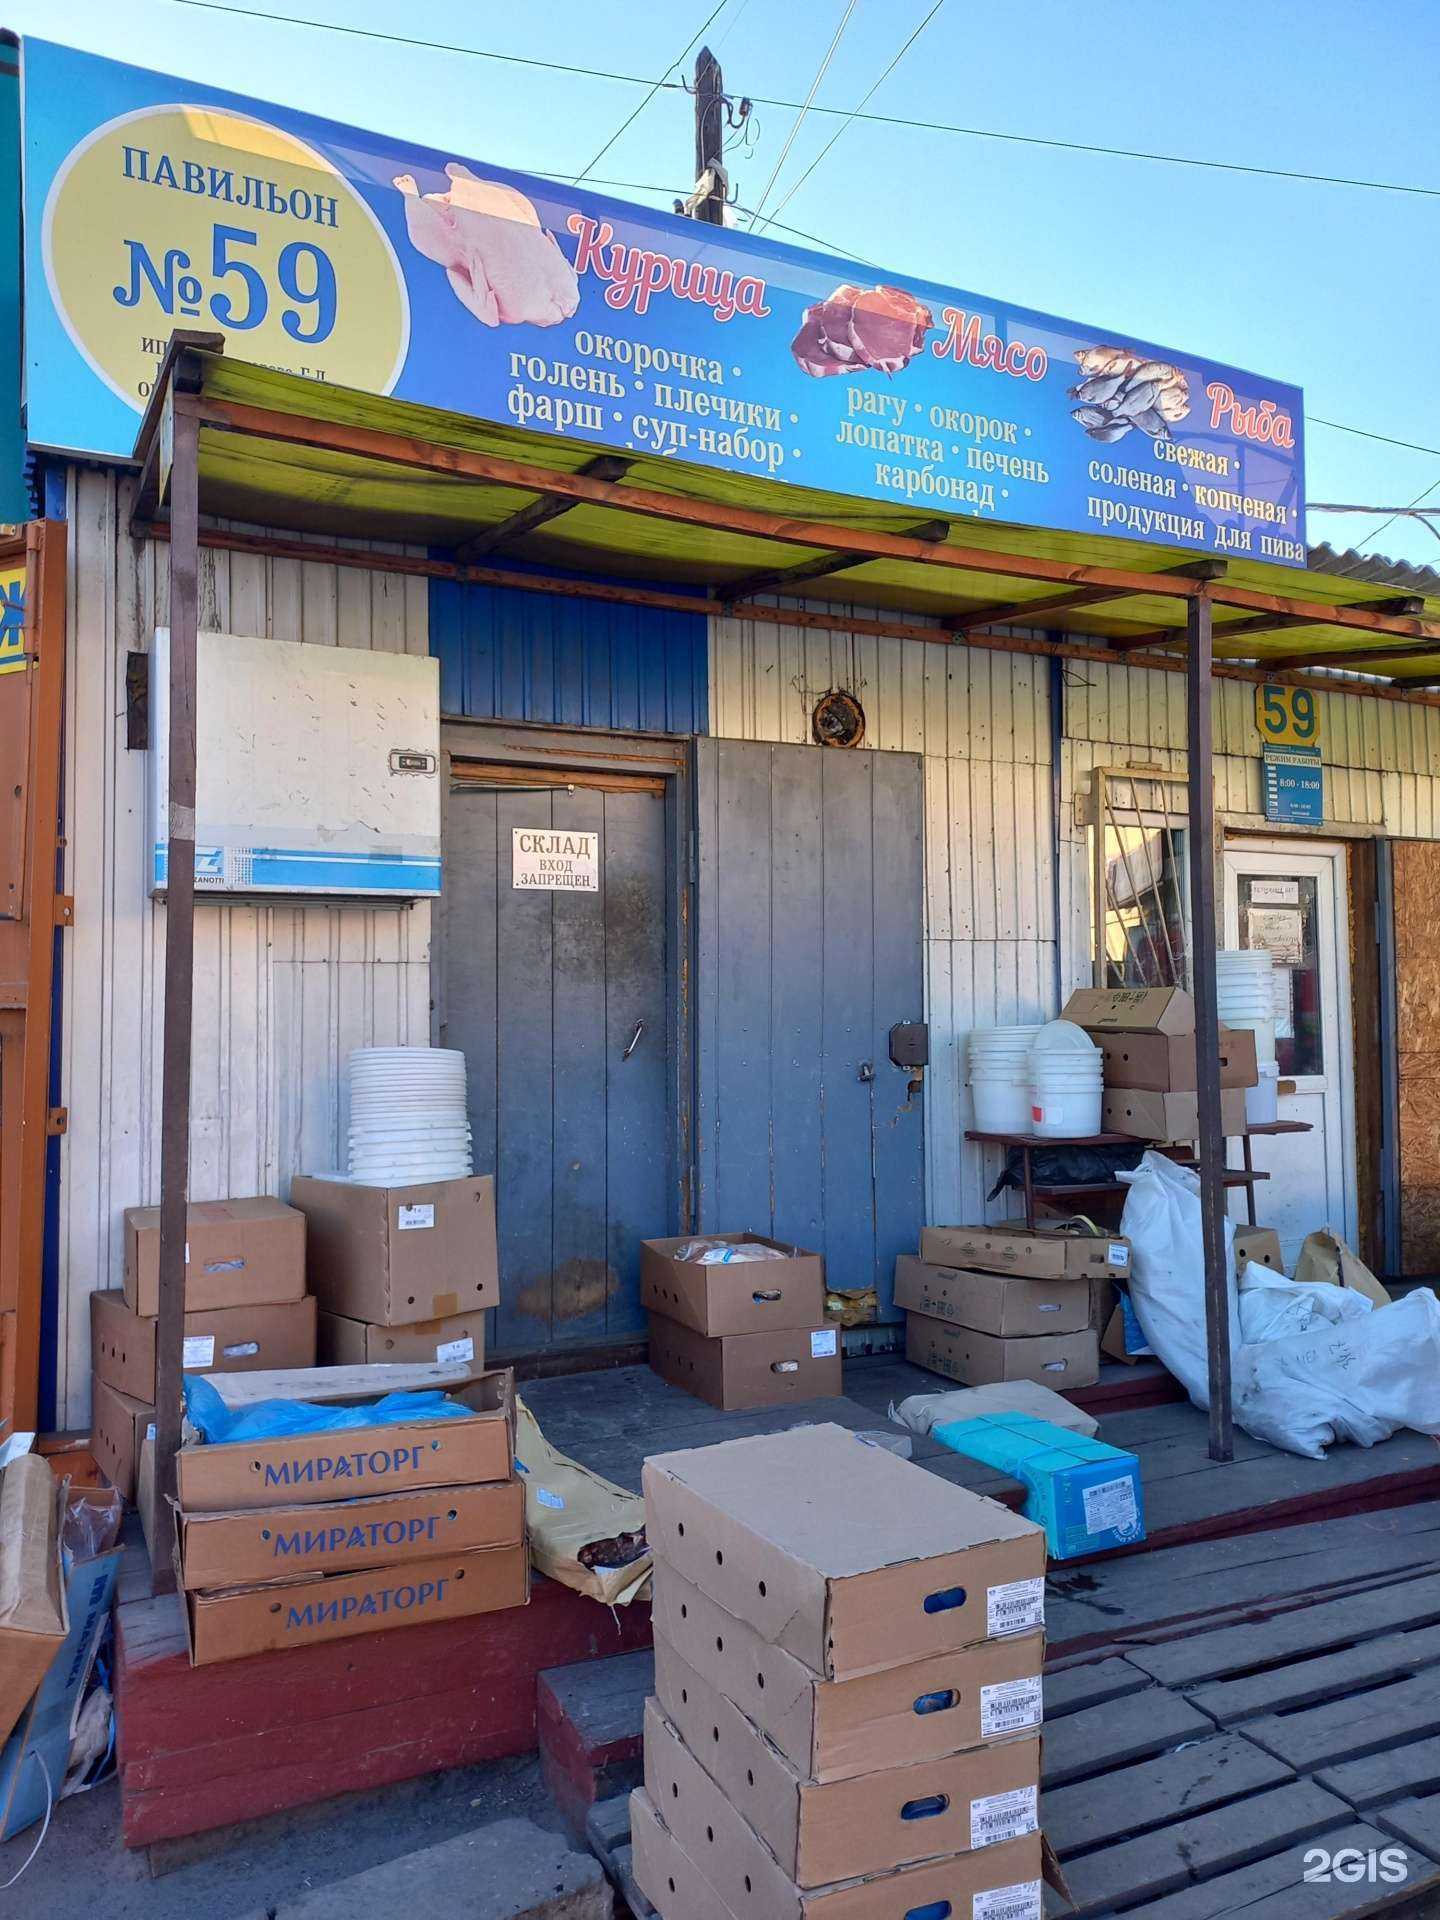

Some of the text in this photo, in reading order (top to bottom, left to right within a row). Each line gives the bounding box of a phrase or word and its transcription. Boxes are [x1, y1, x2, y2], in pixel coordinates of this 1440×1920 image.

[122, 145, 339, 228] ПАВИЛЬОН
[567, 213, 771, 321] Курица
[575, 331, 724, 386] окорочка
[932, 306, 1048, 382] Мясо
[509, 352, 782, 432] голень плечики
[847, 387, 1019, 445] рагу окорок
[1206, 382, 1295, 450] Рыба
[507, 384, 785, 473] фарш суп-набор
[836, 420, 1050, 485] лопатка печень
[875, 462, 995, 507] карбонад
[1153, 439, 1229, 476] свежая
[1088, 459, 1288, 526] соленая копченая
[1087, 495, 1305, 563] продукция для пива
[1263, 685, 1314, 738] 59
[1265, 754, 1320, 766] РЕЖИМ РАБОТЫ
[1280, 778, 1296, 788] 8:00
[1301, 780, 1320, 790] 18:00
[520, 834, 590, 860] СКЛАД
[539, 859, 573, 873] ВХОД
[521, 873, 590, 888] ЗАПРЕЩЕН
[265, 1446, 424, 1487] МИРАТОРГ
[274, 1517, 440, 1557] МИРАТОРГ
[287, 1579, 449, 1629] МИРАТОРГ
